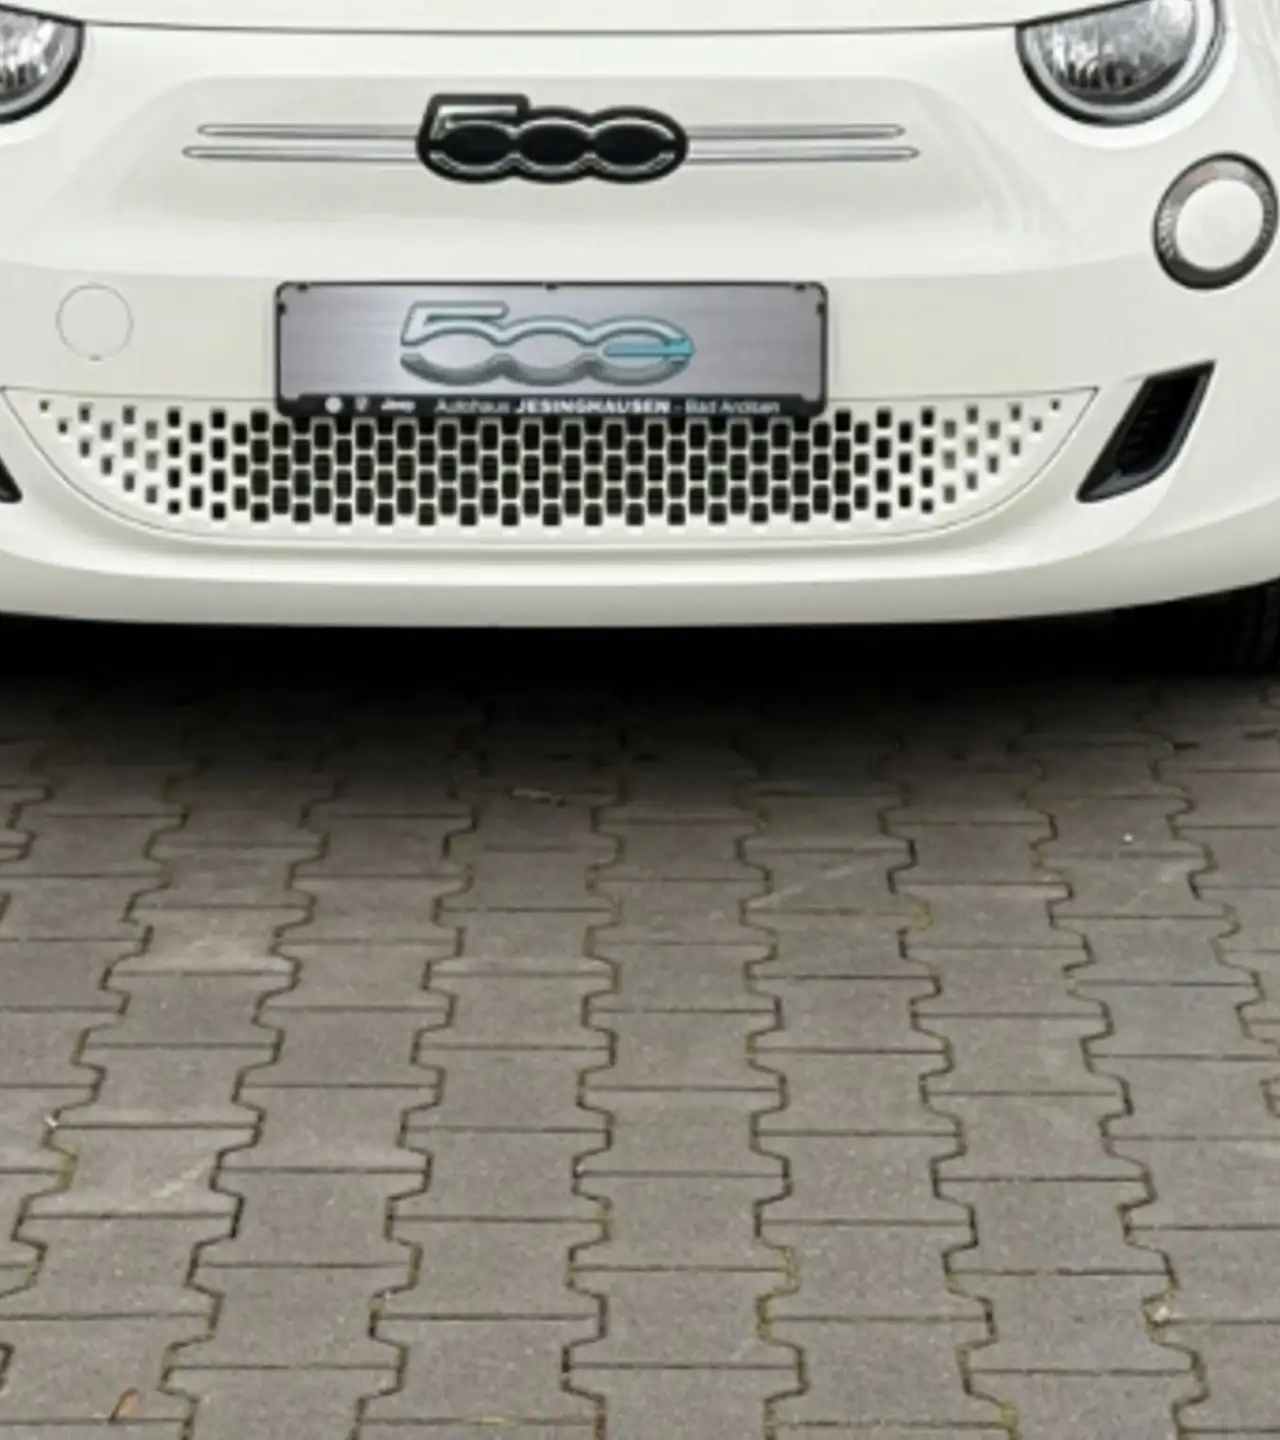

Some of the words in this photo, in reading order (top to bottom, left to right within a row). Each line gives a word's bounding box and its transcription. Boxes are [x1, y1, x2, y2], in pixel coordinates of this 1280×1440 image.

[418, 95, 684, 182] 500
[434, 397, 510, 413] Autohaus
[516, 397, 670, 414] JESINGHAUSEN
